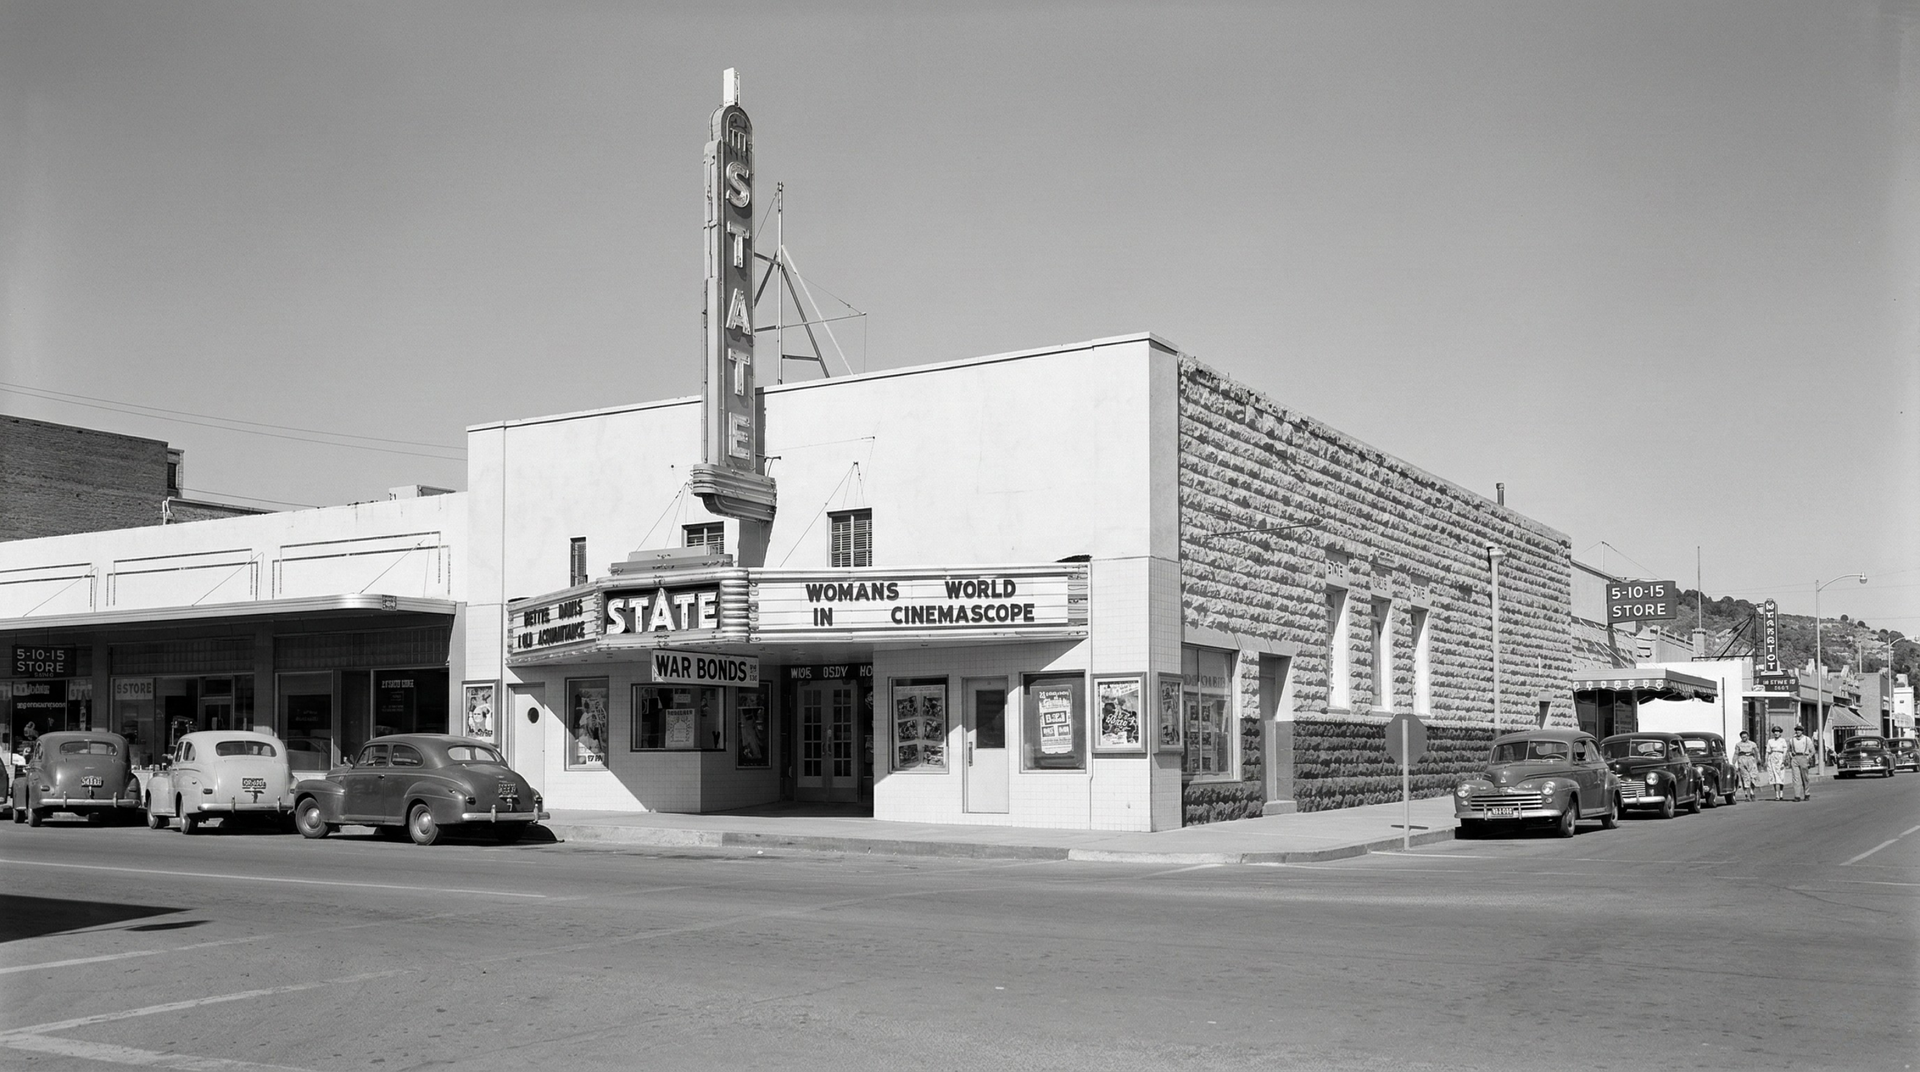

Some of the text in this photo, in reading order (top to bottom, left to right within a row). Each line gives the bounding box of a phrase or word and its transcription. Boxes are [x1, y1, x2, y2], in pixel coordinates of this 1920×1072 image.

[725, 161, 751, 460] STATE
[805, 578, 1017, 603] WOMANS WORLD
[1612, 585, 1664, 600] 5-10-15
[559, 598, 583, 621] DAVIS
[605, 587, 718, 635] STATE
[813, 603, 1036, 627] IN CINEMASCOPE
[1612, 603, 1666, 617] STORE
[16, 648, 65, 661] 5-10-15
[16, 661, 65, 673] STORE
[655, 654, 692, 678] WAR
[696, 657, 747, 683] BONDS
